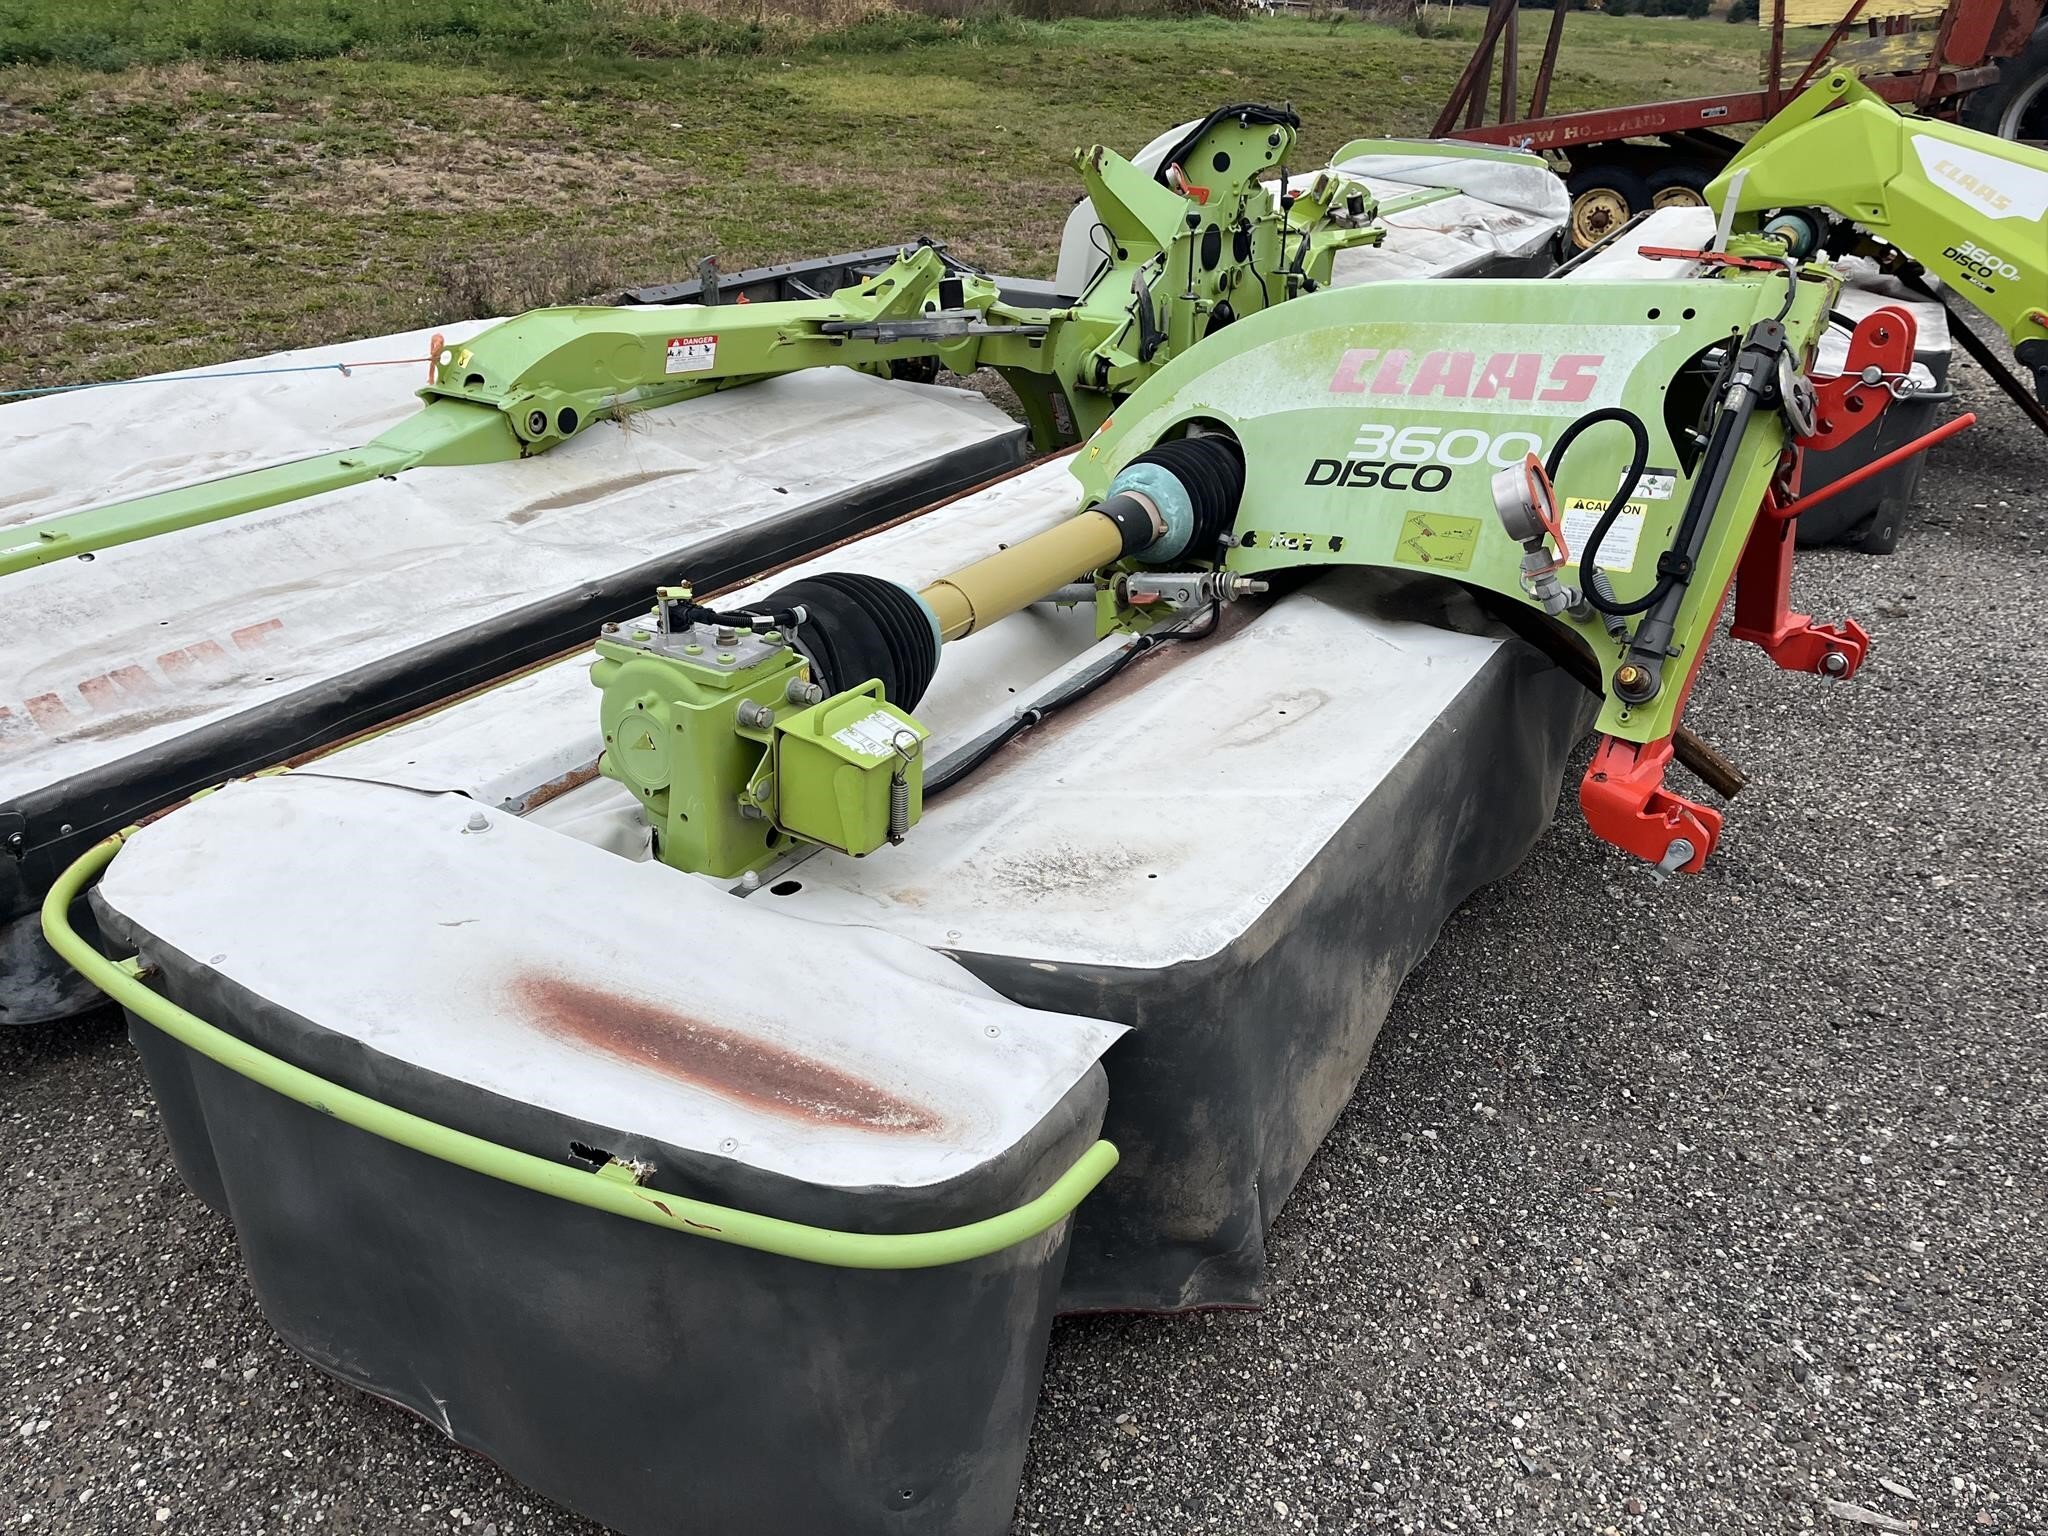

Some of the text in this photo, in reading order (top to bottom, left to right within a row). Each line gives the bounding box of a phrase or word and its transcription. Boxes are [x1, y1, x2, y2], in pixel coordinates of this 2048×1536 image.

[1564, 114, 1666, 139] HOLAND
[1935, 159, 2011, 210] CLAAS
[1942, 247, 1993, 278] DISCO
[683, 337, 713, 345] DANGER
[1329, 348, 1605, 402] CLAAS
[1305, 459, 1452, 492] DISCO
[1586, 501, 1641, 515] CAUON
